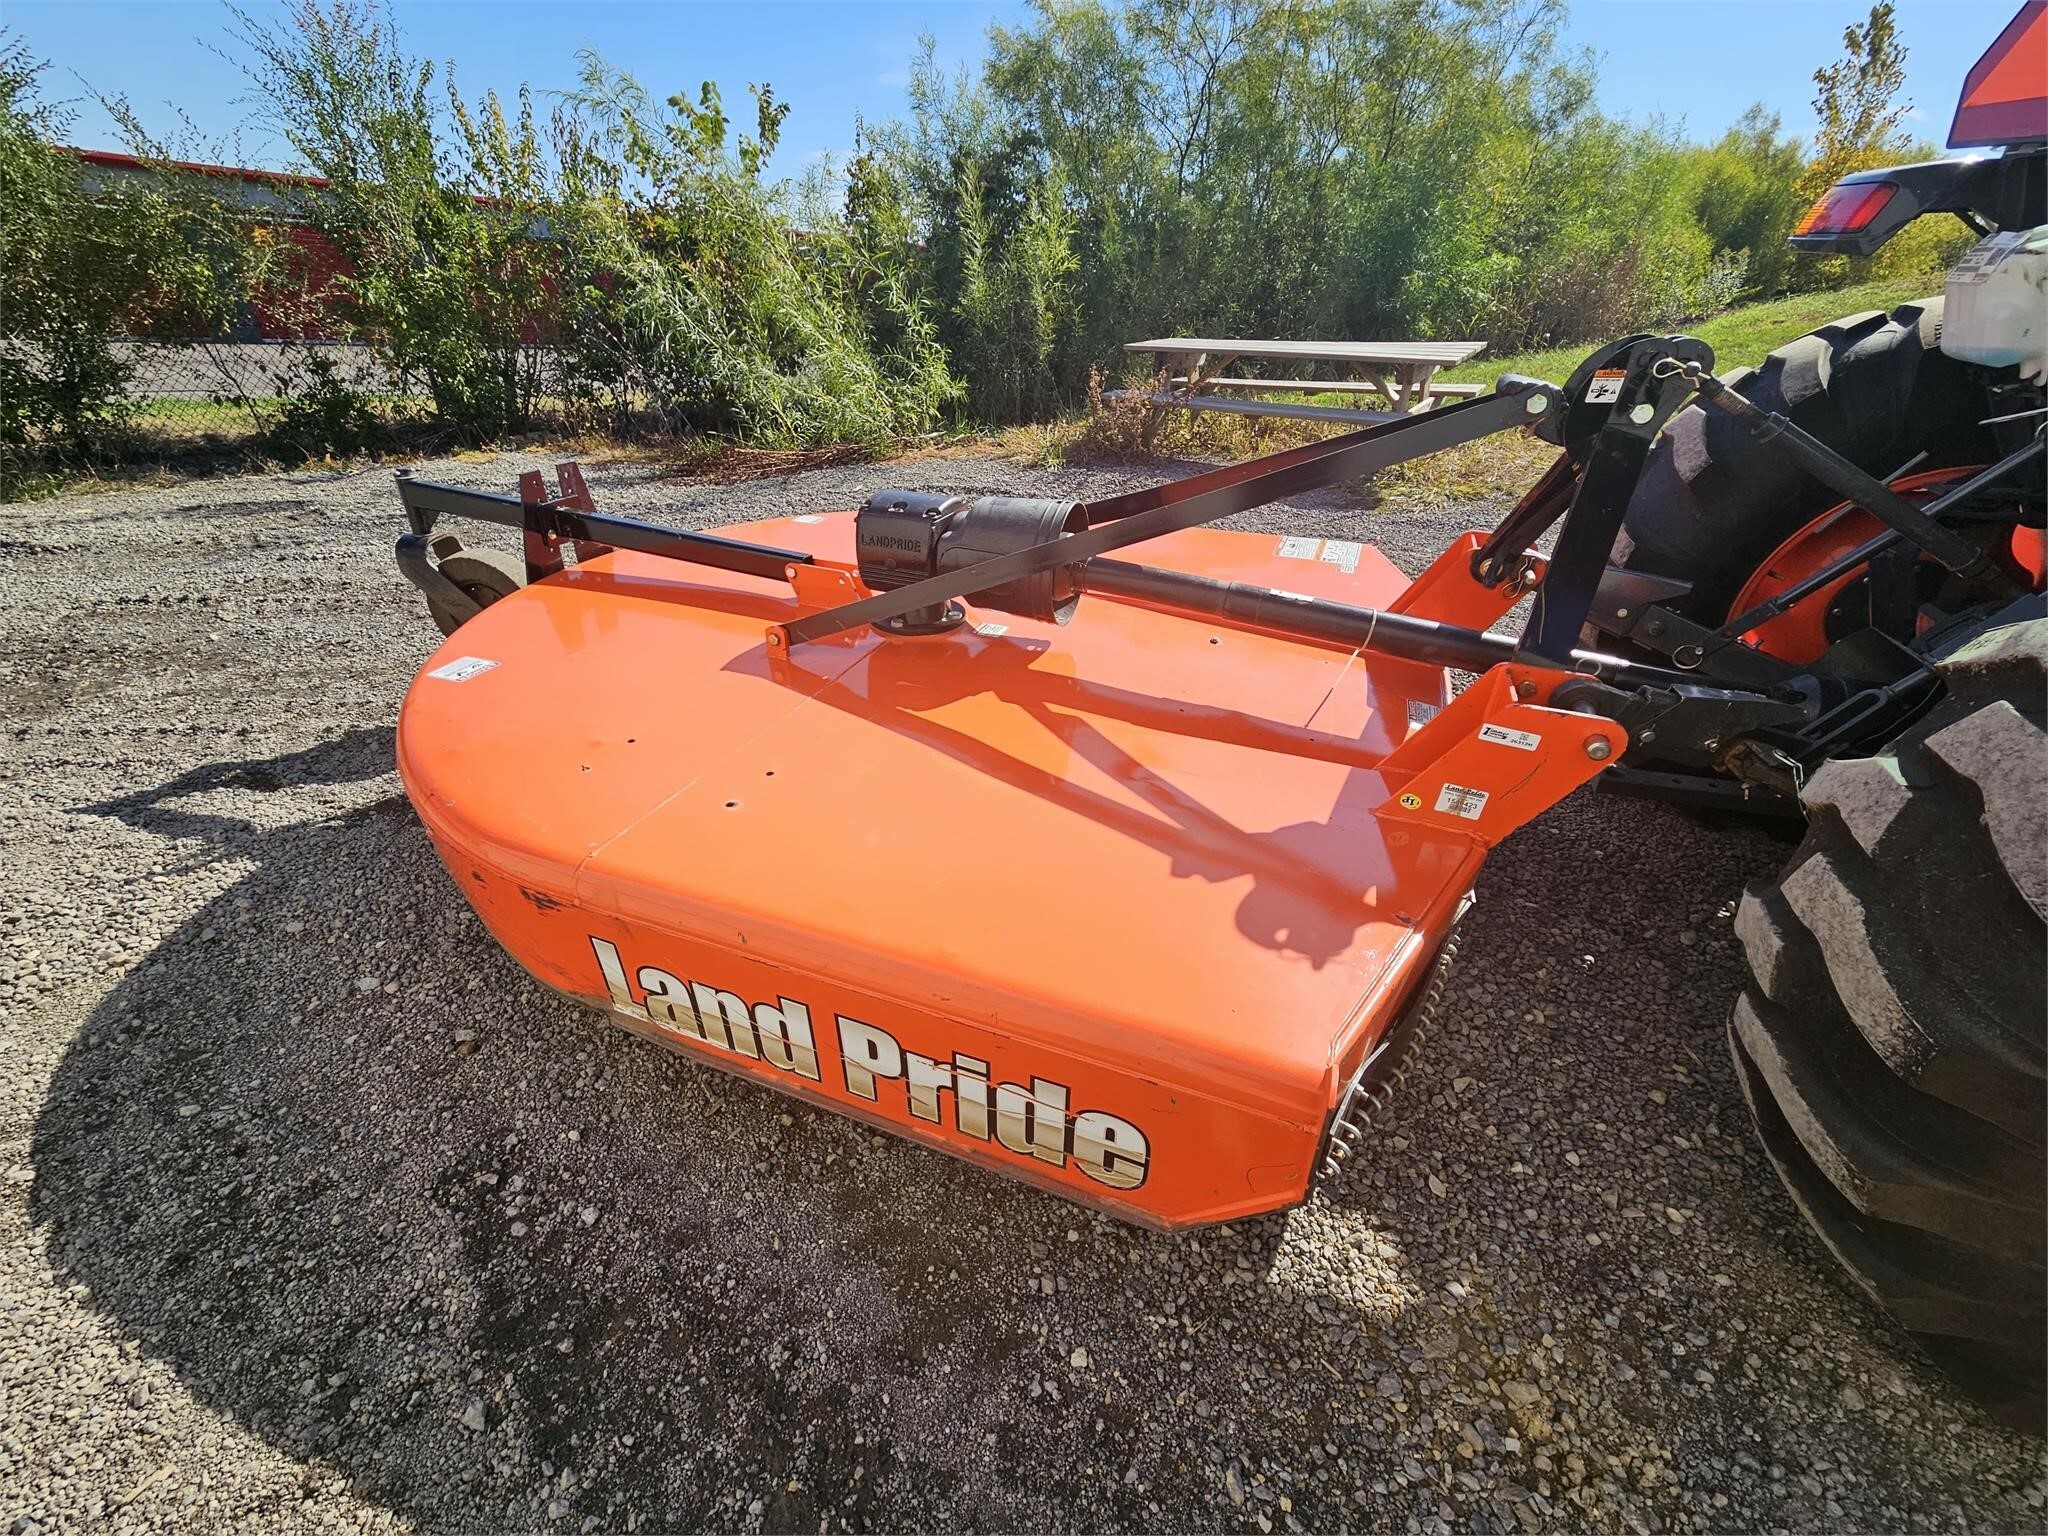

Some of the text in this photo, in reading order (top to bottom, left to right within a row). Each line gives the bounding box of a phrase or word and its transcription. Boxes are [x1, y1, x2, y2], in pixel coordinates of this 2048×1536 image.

[861, 534, 921, 553] LANDPRIDE
[588, 935, 1151, 1190] Land Pride
